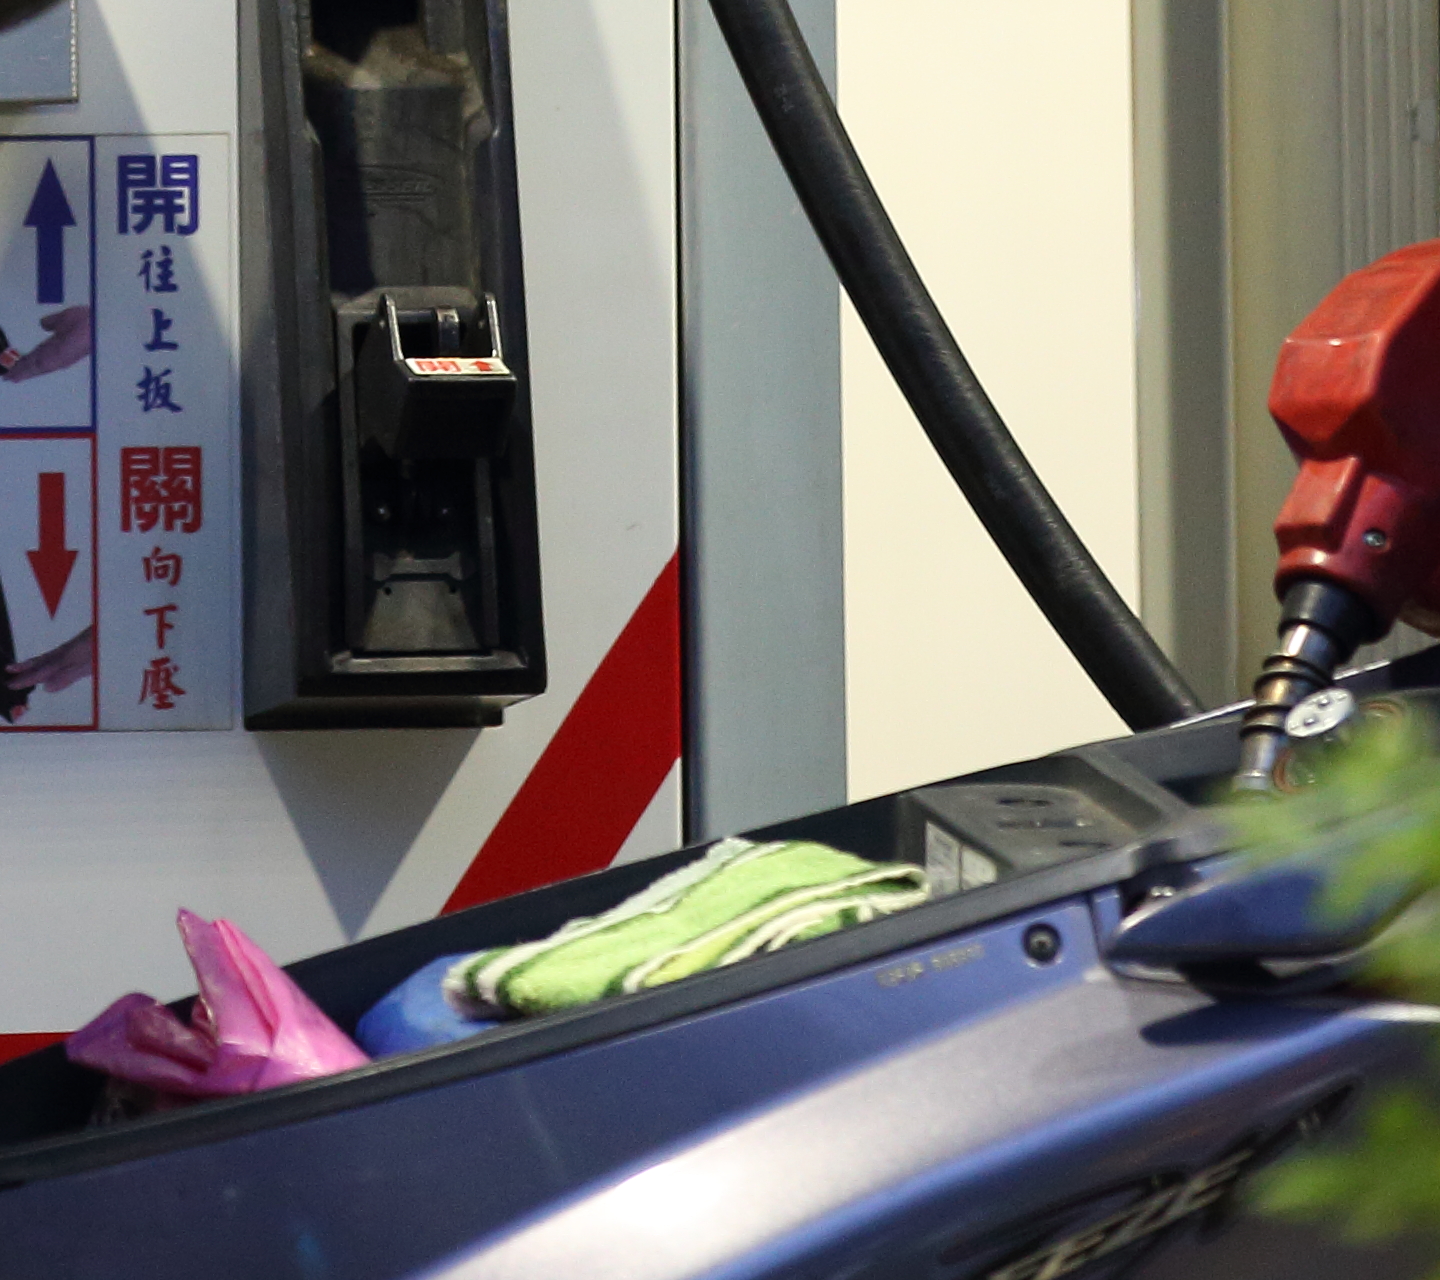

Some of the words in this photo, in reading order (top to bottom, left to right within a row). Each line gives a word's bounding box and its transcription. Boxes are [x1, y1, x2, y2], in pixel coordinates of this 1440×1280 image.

[118, 155, 199, 236] 開
[120, 446, 202, 533] 關
[139, 544, 185, 709] 向下壓
